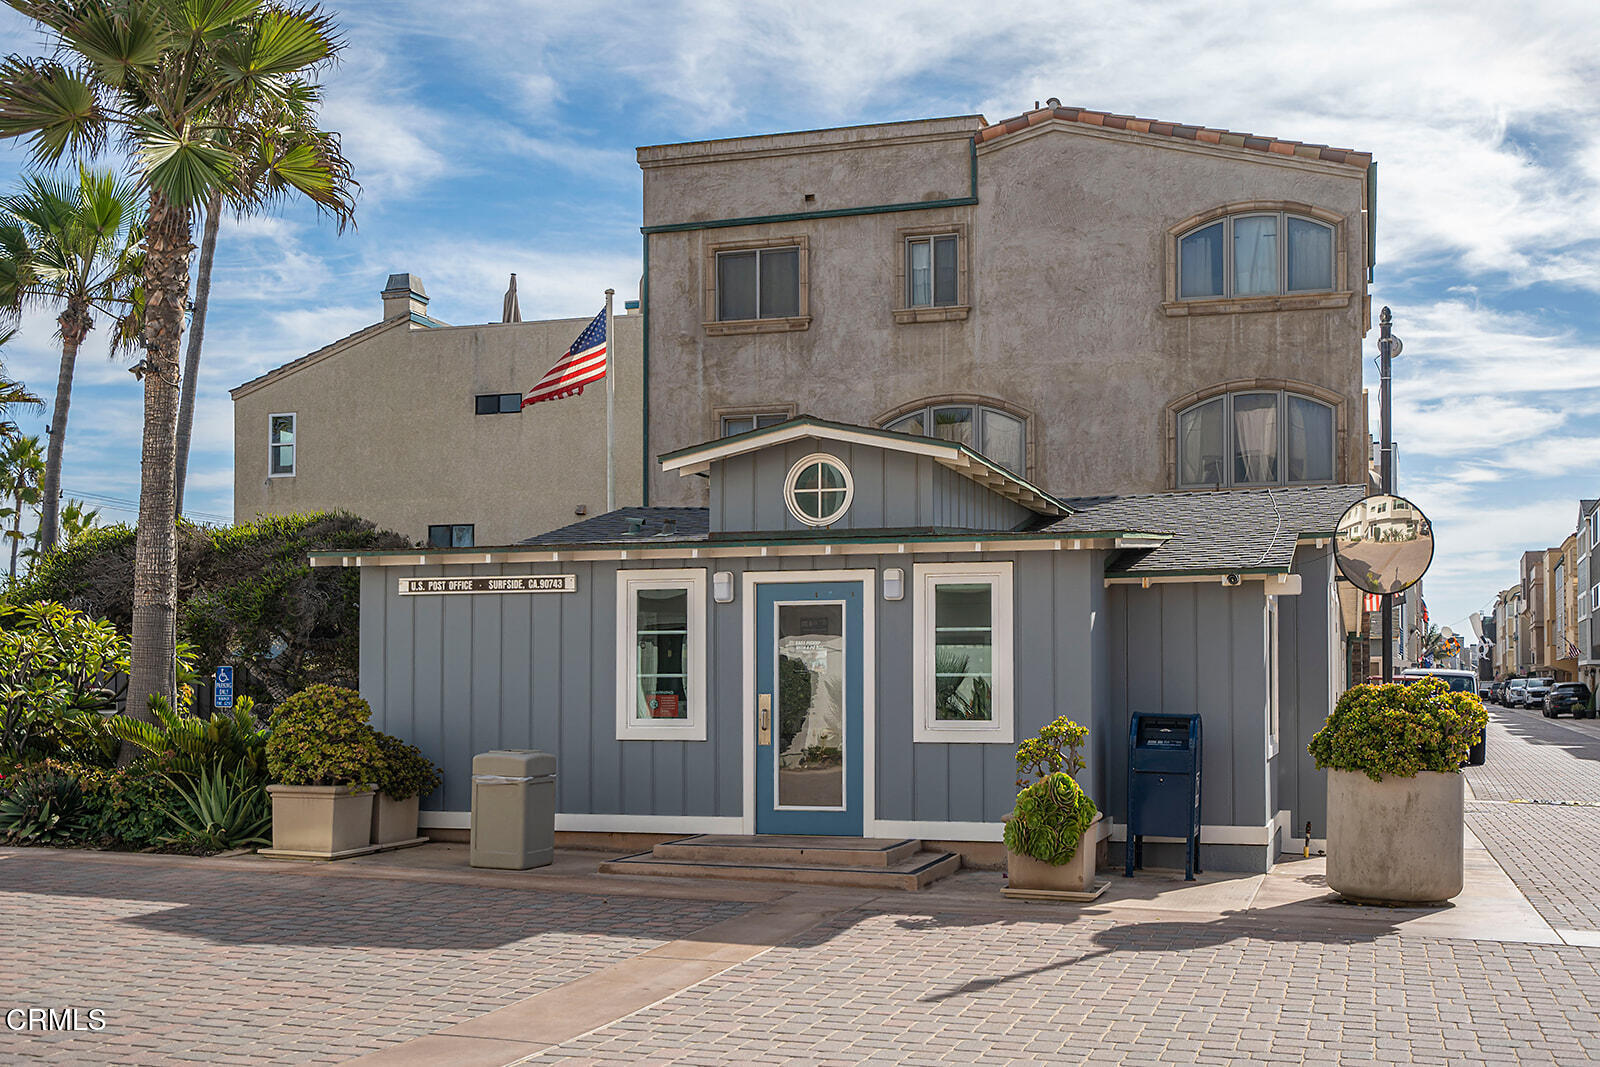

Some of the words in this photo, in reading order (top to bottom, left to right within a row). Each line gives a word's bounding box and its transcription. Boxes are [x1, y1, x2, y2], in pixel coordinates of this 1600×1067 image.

[411, 581, 425, 591] U.S.
[428, 581, 446, 591] POST
[448, 580, 473, 590] OFFICE
